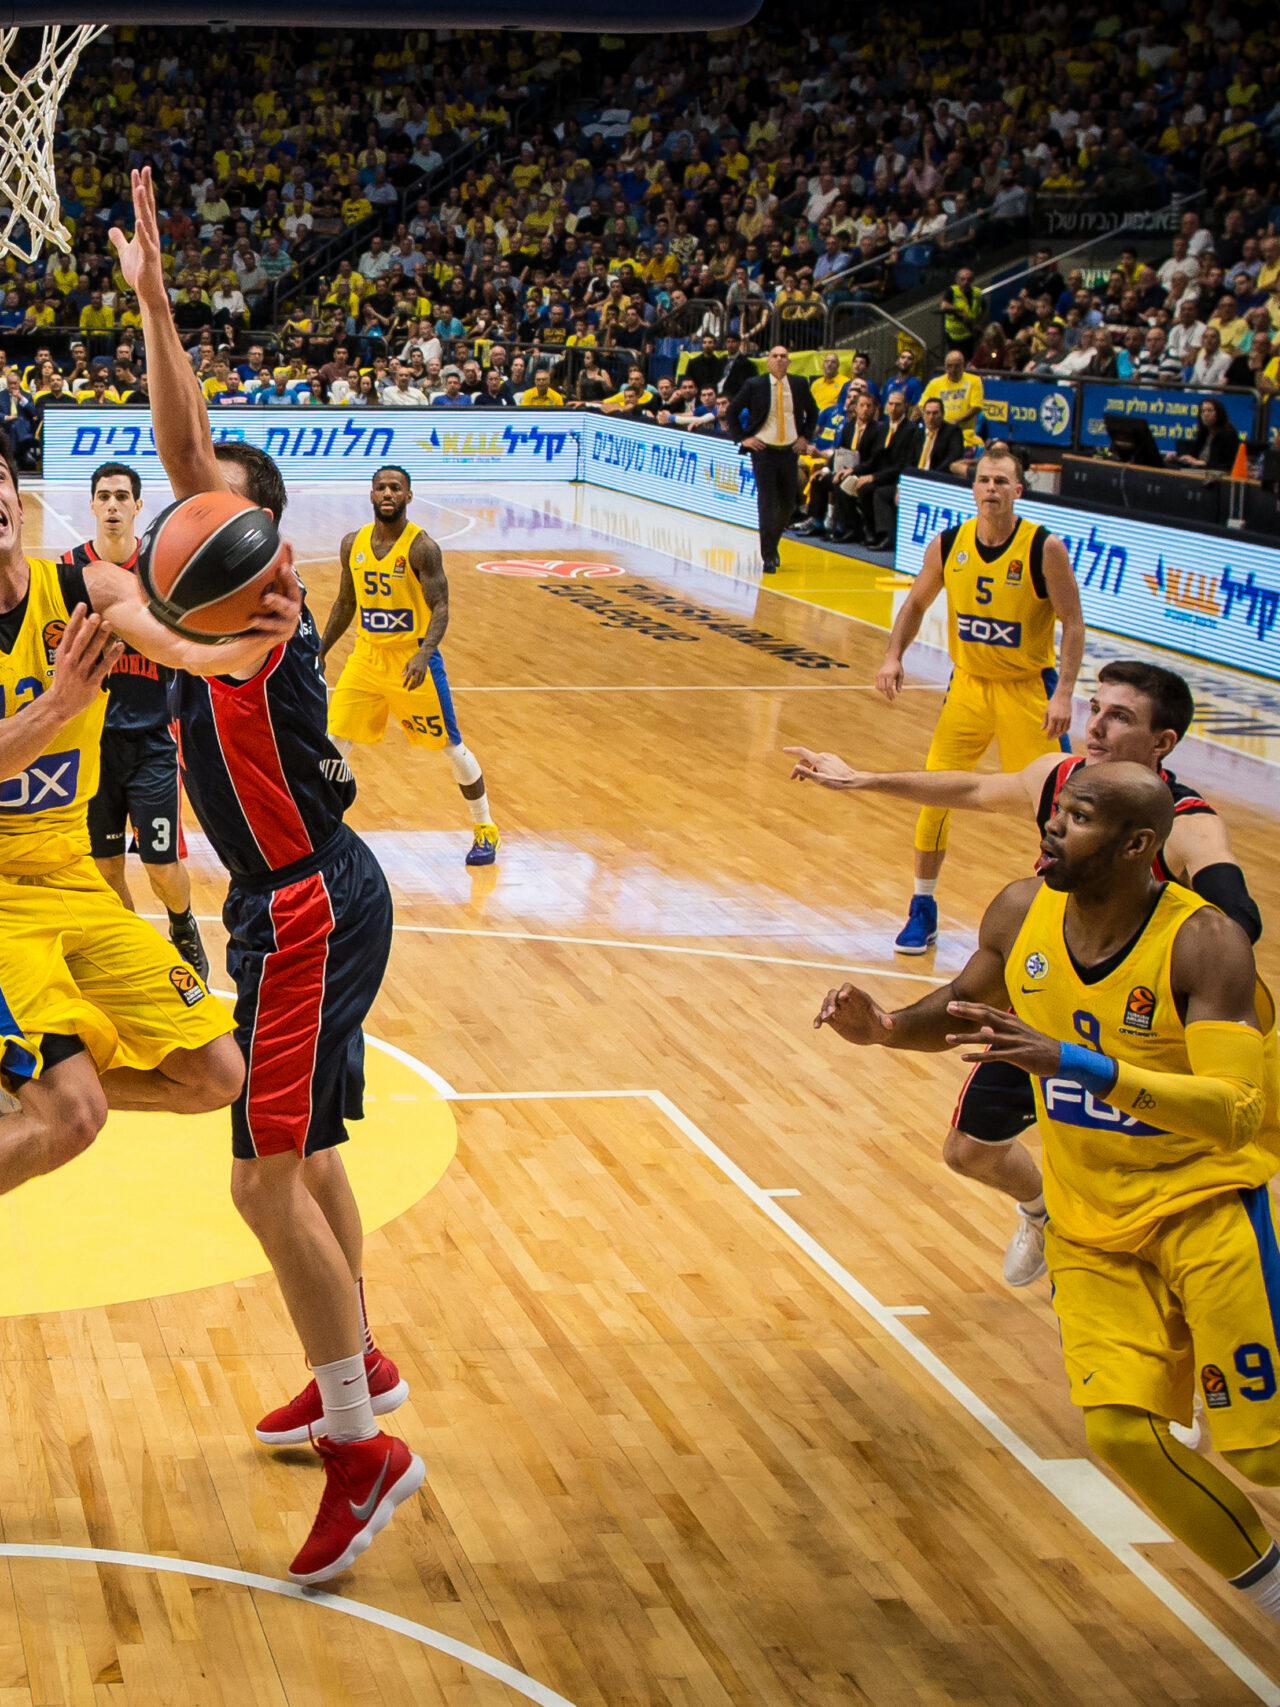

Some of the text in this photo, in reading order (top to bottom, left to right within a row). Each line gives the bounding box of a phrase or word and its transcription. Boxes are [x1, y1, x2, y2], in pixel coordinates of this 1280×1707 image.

[264, 418, 395, 457] חלונות
[502, 425, 568, 463] קליל
[592, 431, 698, 485] חלונות מעוצבים
[364, 571, 392, 596] 55
[976, 576, 993, 605] 5
[957, 617, 1015, 645] FOX
[411, 715, 443, 738] 55
[151, 817, 171, 852] 3
[1073, 1009, 1104, 1056] 9
[1046, 1078, 1139, 1126] FO
[1233, 1342, 1277, 1401] 9
